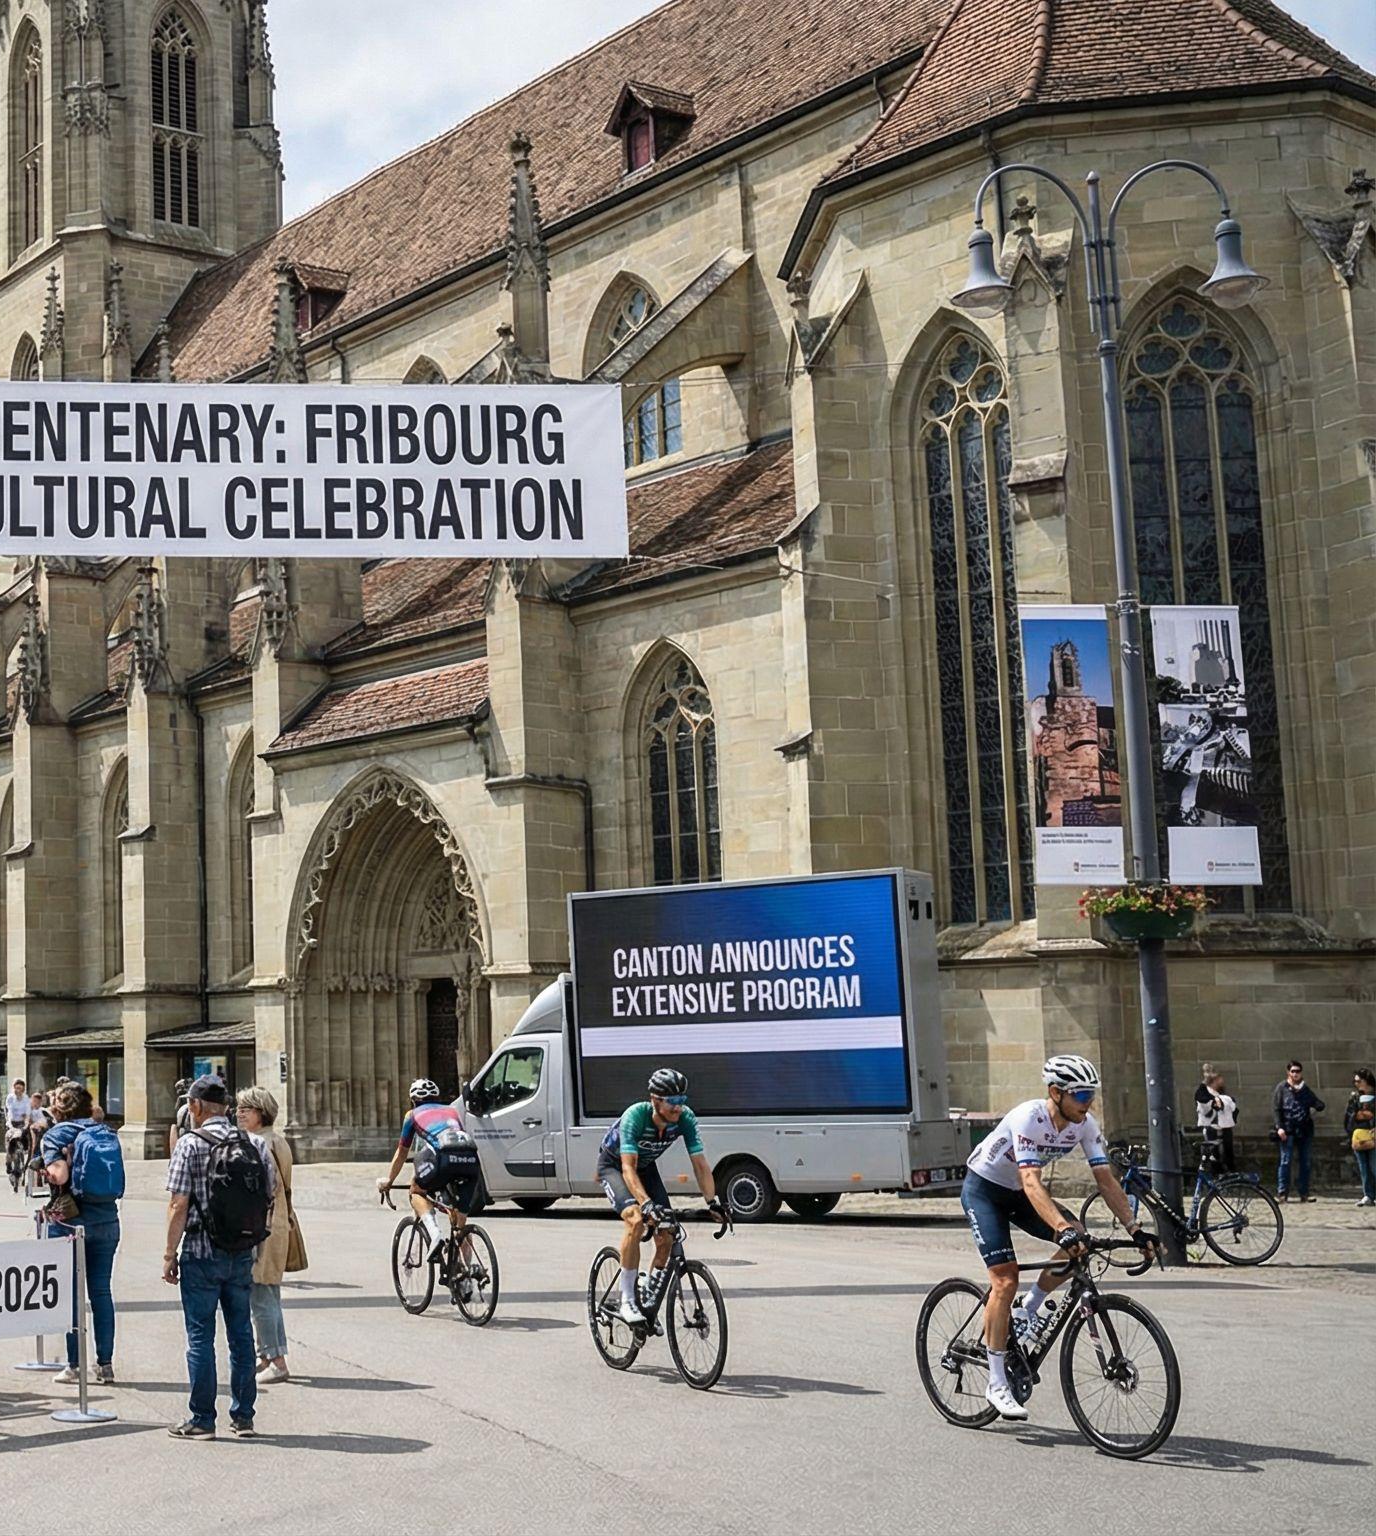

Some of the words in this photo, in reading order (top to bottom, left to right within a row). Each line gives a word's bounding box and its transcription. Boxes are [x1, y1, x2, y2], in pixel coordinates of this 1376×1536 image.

[305, 403, 565, 466] FRIBOURG
[224, 476, 584, 541] CELEBRATION
[613, 943, 704, 979] CANTON
[710, 934, 856, 974] ANNOUNCES
[612, 980, 736, 1017] EXTENSIVE
[742, 974, 861, 1012] PROGRAM
